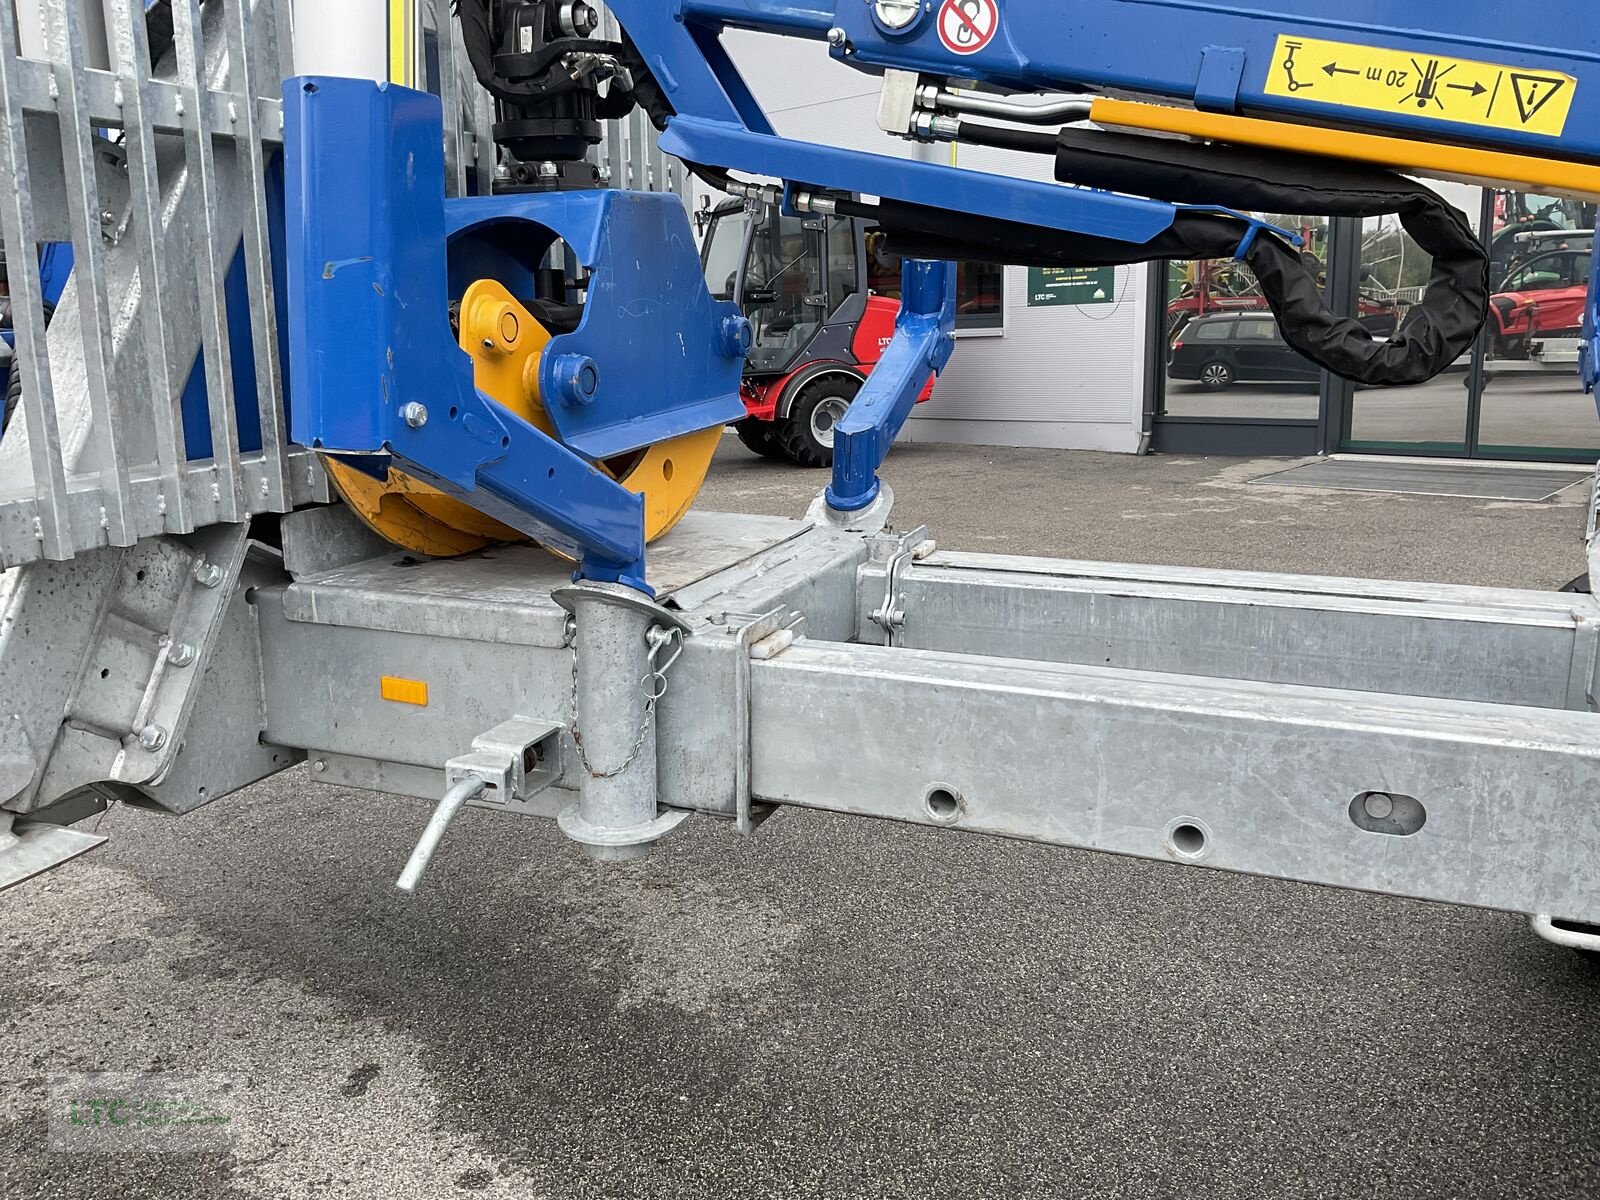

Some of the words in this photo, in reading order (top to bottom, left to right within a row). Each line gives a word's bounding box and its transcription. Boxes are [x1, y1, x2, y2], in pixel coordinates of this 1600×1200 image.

[1366, 66, 1382, 81] m
[1386, 70, 1408, 88] 20
[1034, 293, 1046, 301] LTC
